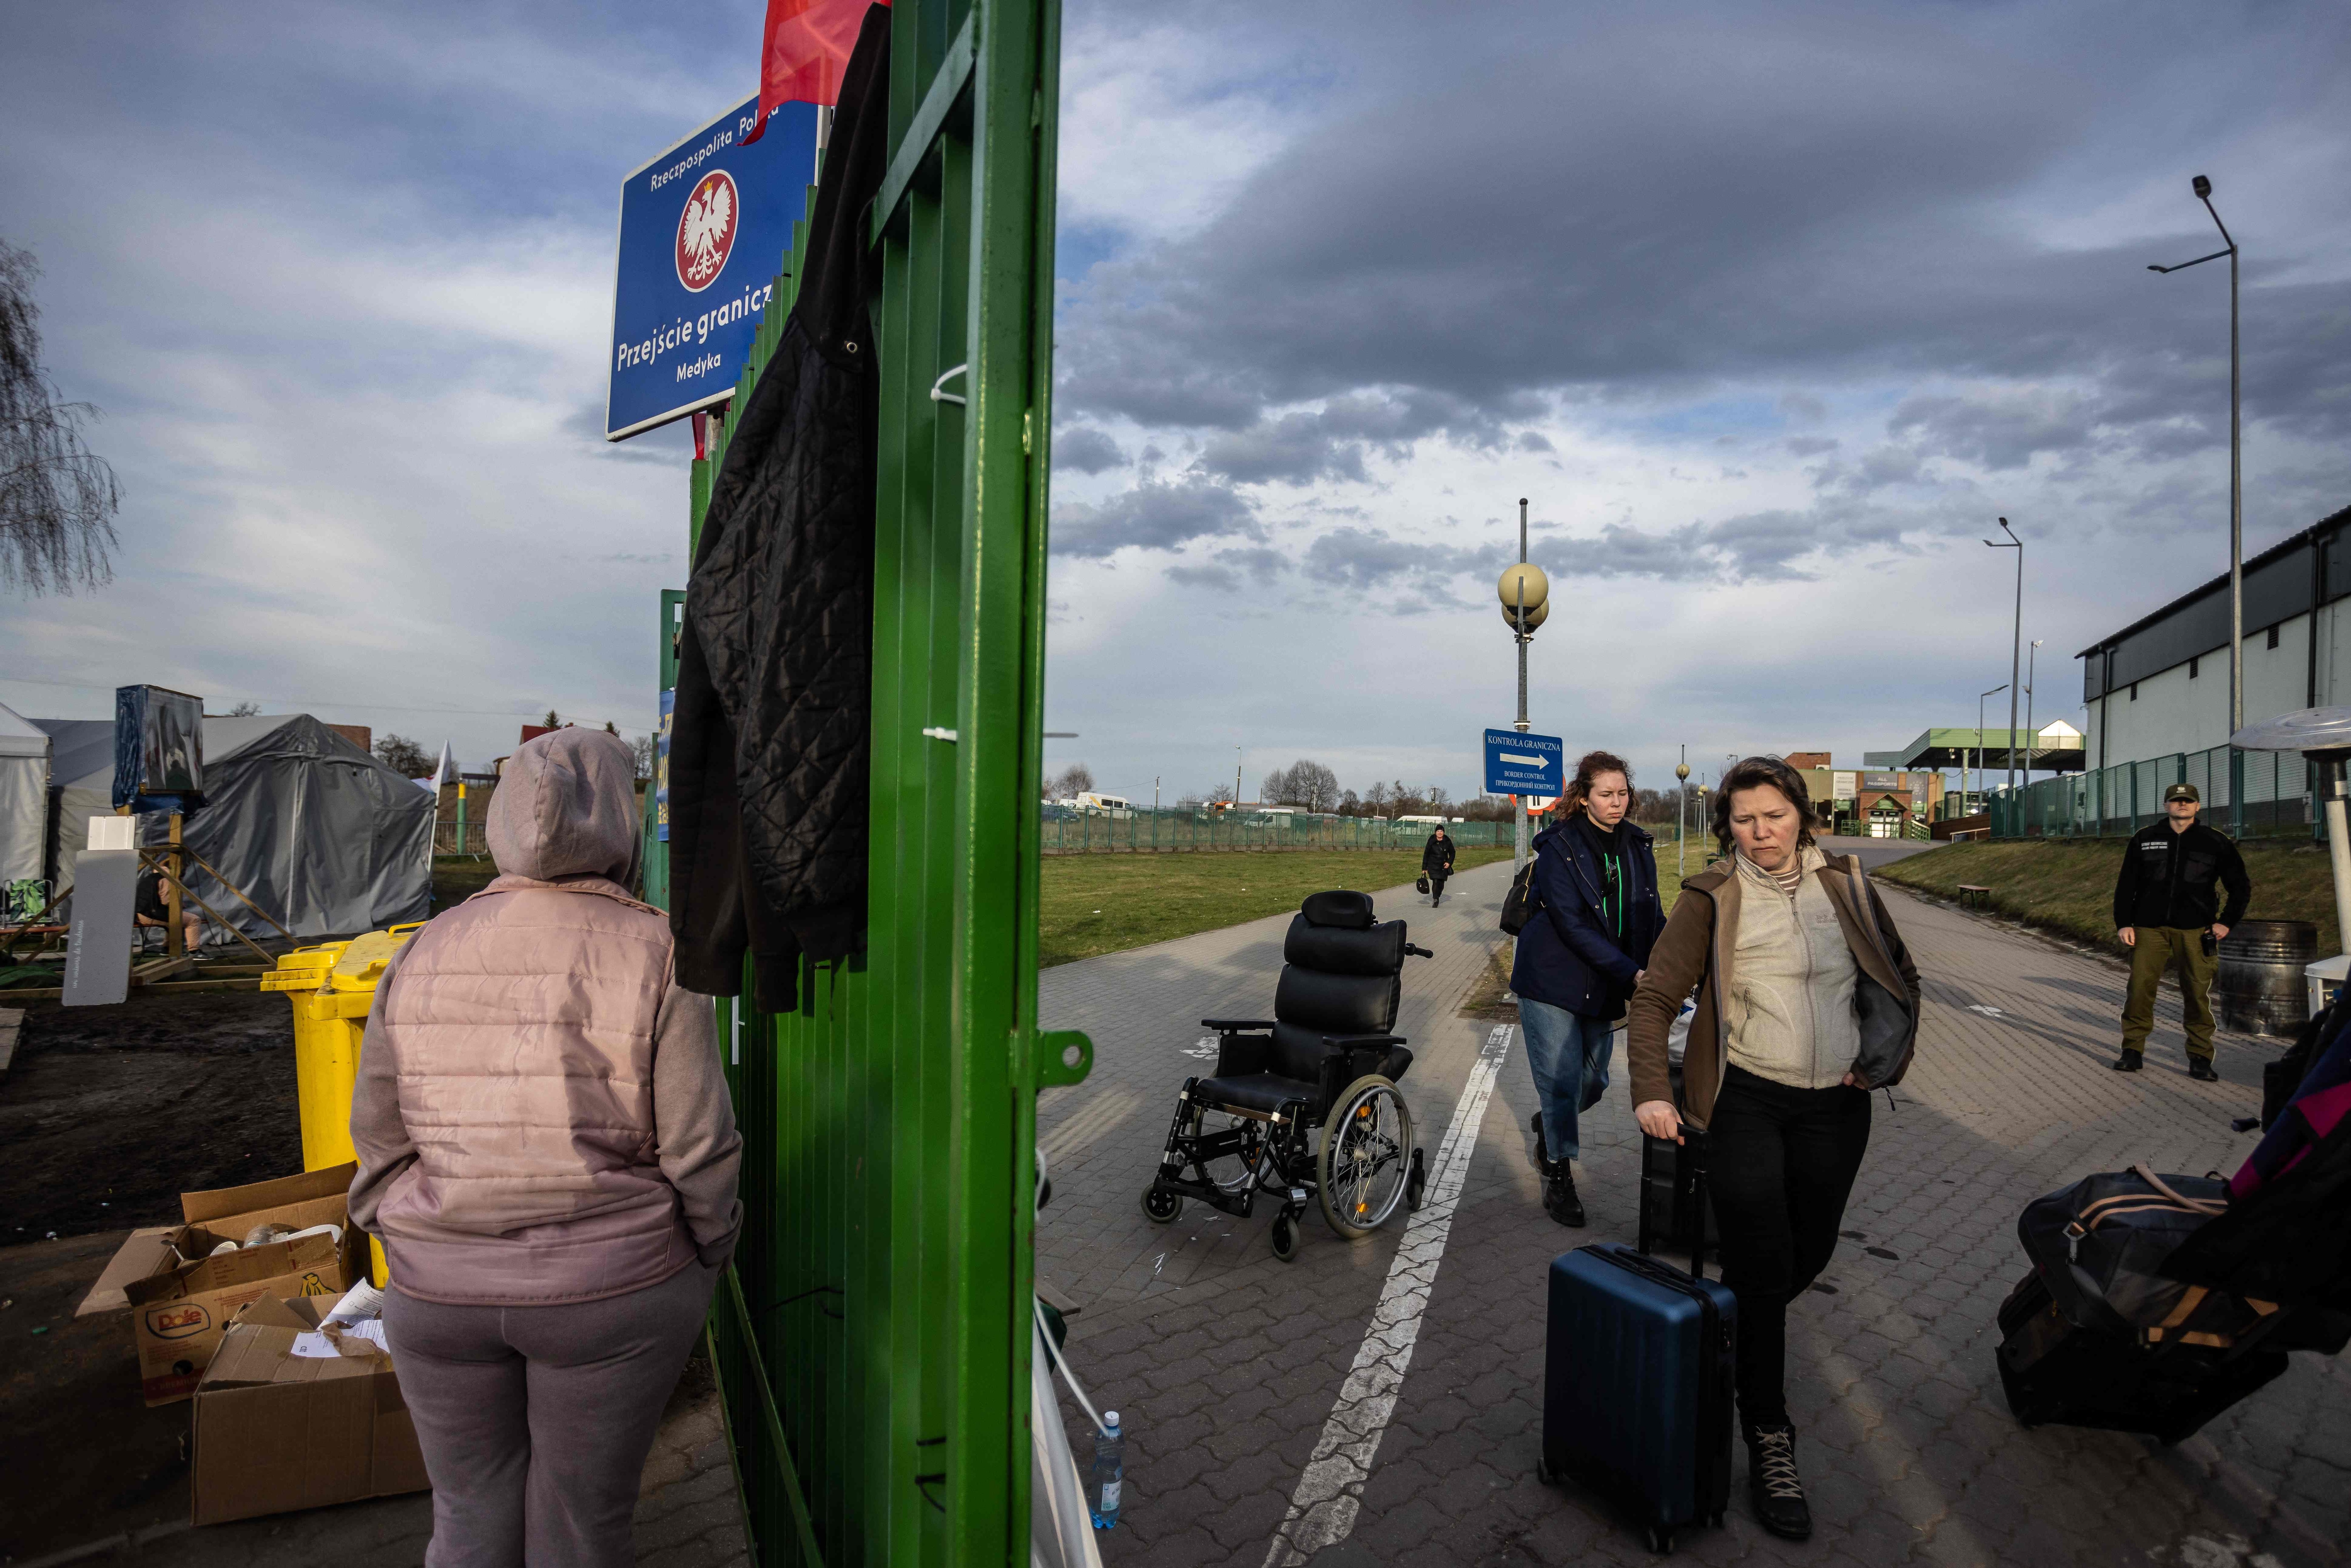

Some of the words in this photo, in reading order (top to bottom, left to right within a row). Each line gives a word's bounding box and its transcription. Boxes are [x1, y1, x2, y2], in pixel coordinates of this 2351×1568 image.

[651, 131, 733, 192] Rzeczpospolita
[739, 105, 780, 137] Pola
[618, 318, 693, 371] Przejście
[676, 352, 721, 382] Medyka
[1488, 735, 1523, 747] KONTROLA
[1524, 740, 1560, 751] GRANICZNA
[1496, 780, 1533, 788] ПРИКОРДОННИЙ
[158, 1309, 202, 1329] Dole
